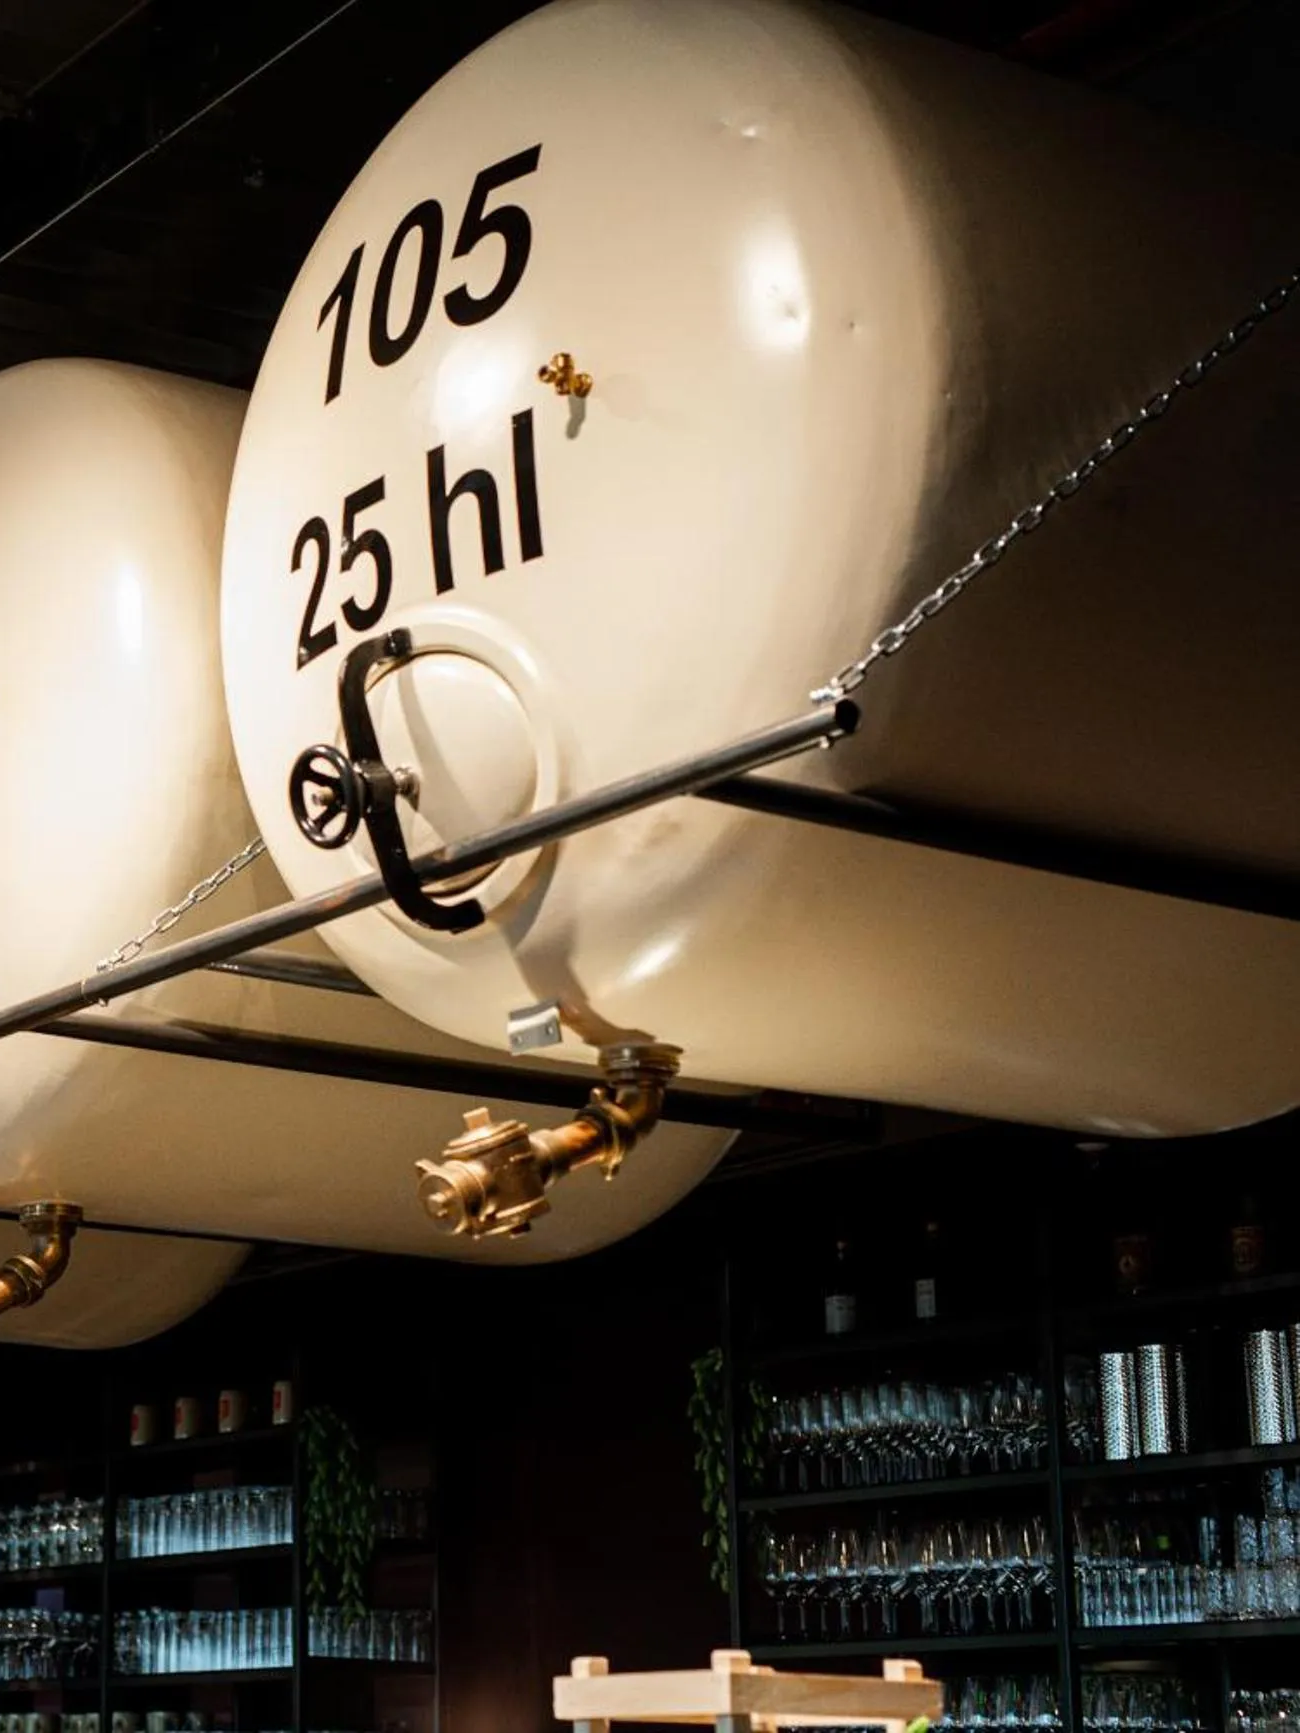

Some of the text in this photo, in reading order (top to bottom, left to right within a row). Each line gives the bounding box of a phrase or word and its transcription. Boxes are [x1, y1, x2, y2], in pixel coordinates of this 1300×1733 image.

[317, 143, 542, 406] 105
[291, 407, 544, 671] 25 hl
